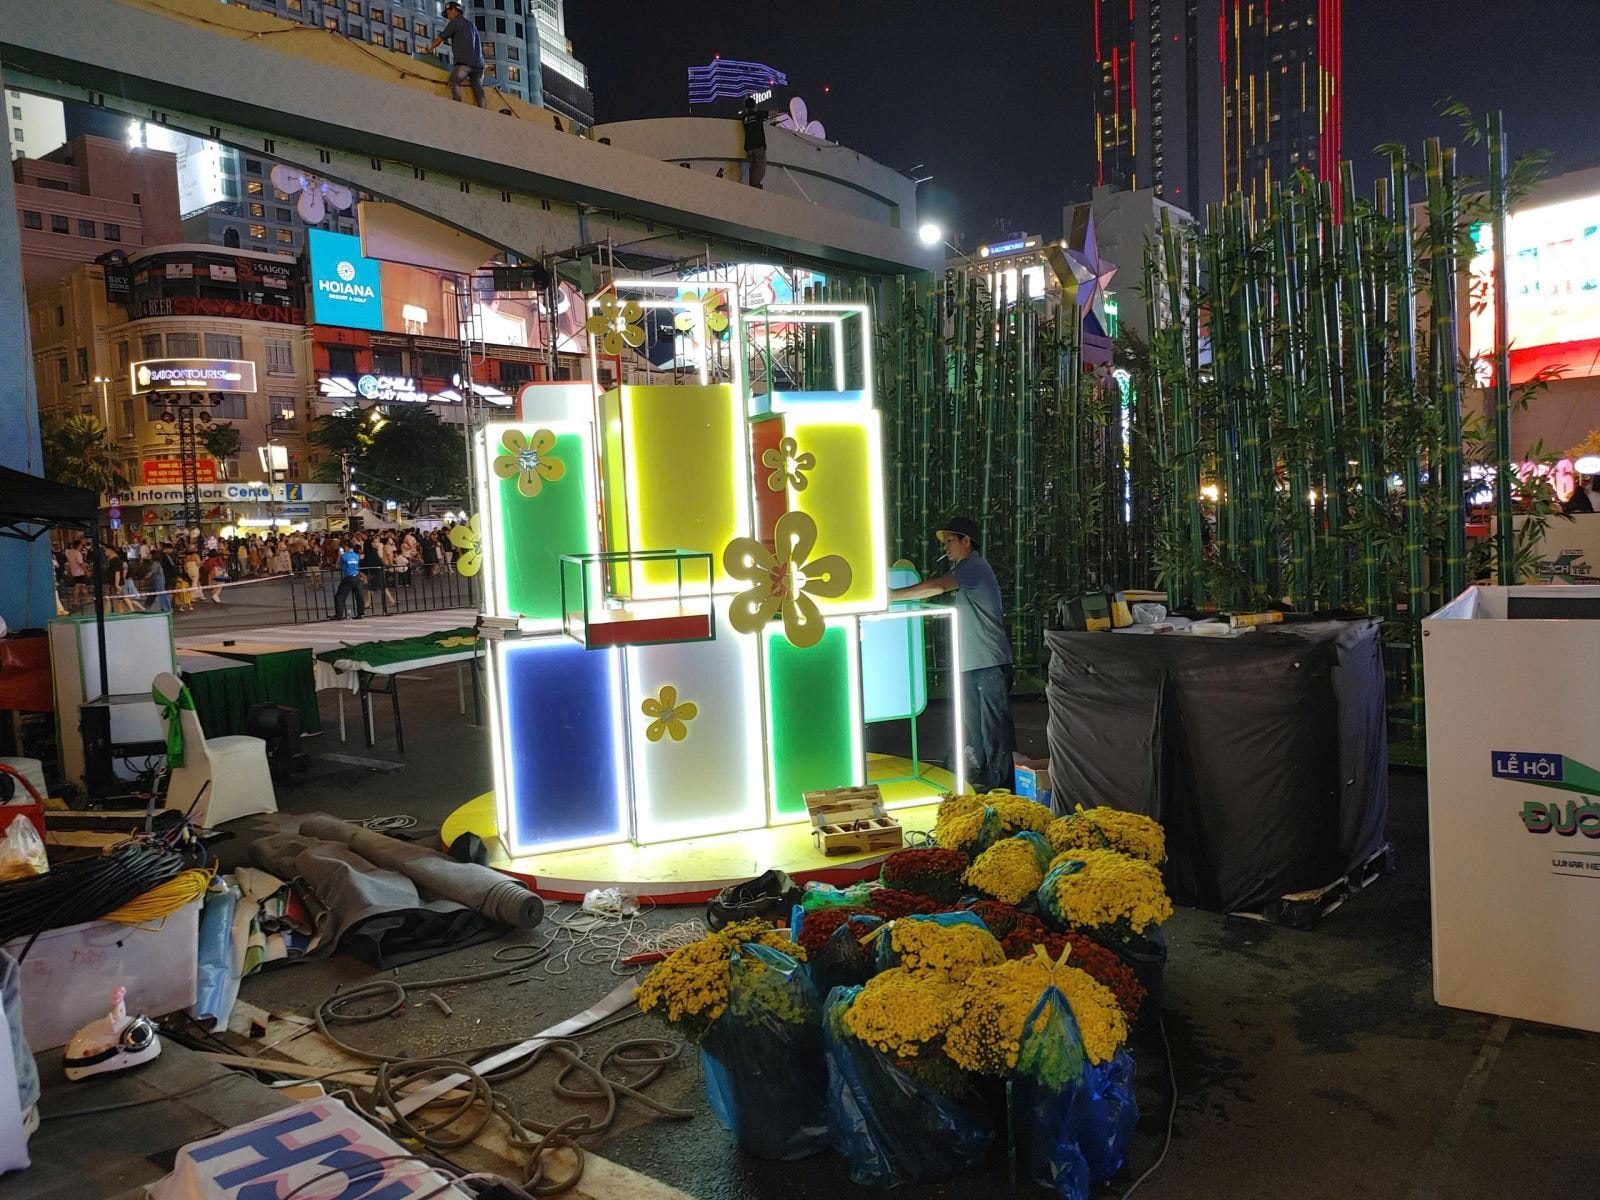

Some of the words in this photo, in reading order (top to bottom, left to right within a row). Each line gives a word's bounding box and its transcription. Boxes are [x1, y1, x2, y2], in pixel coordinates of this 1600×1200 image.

[257, 263, 290, 276] SAIGON
[108, 275, 129, 284] SKY
[319, 279, 375, 298] HOIANA
[328, 293, 348, 301] RESORT
[148, 299, 173, 316] BEER
[174, 298, 231, 316] SKY
[240, 302, 303, 324] ZONE
[150, 369, 227, 380] SAIGONTOURIST
[377, 376, 416, 391] CHILL
[1496, 753, 1520, 775] LỄ
[1523, 757, 1556, 779] HỘI
[1552, 859, 1584, 870] LUNAR
